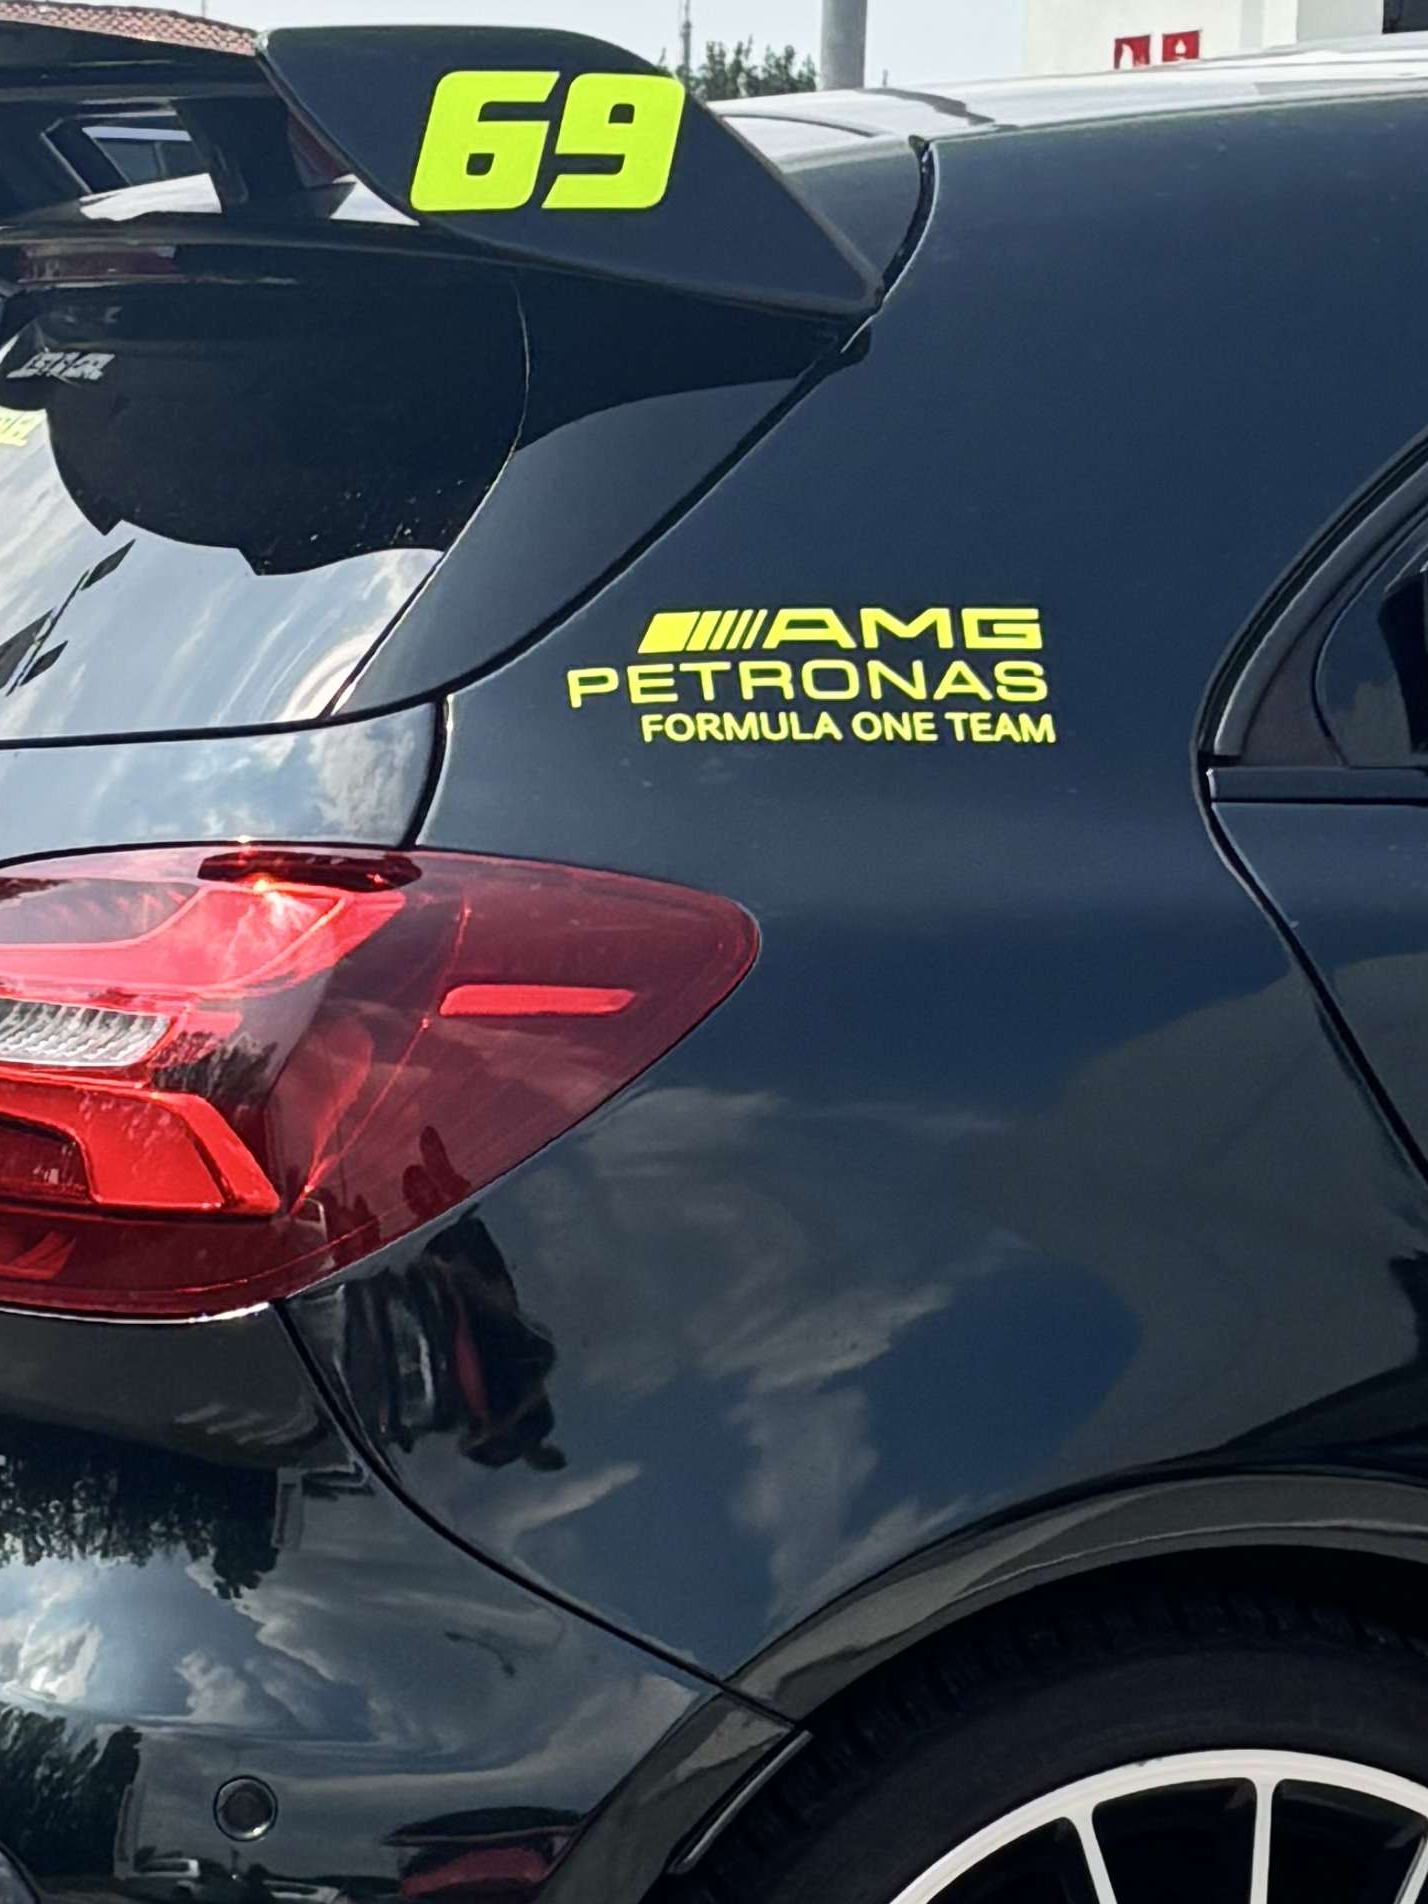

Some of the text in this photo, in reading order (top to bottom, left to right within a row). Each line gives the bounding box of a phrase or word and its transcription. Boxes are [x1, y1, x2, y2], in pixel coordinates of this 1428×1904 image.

[411, 72, 685, 211] 69
[762, 607, 1046, 649] AMG
[567, 660, 1047, 708] PETRONAS
[641, 712, 1057, 743] FORMULA ONE TEAM
